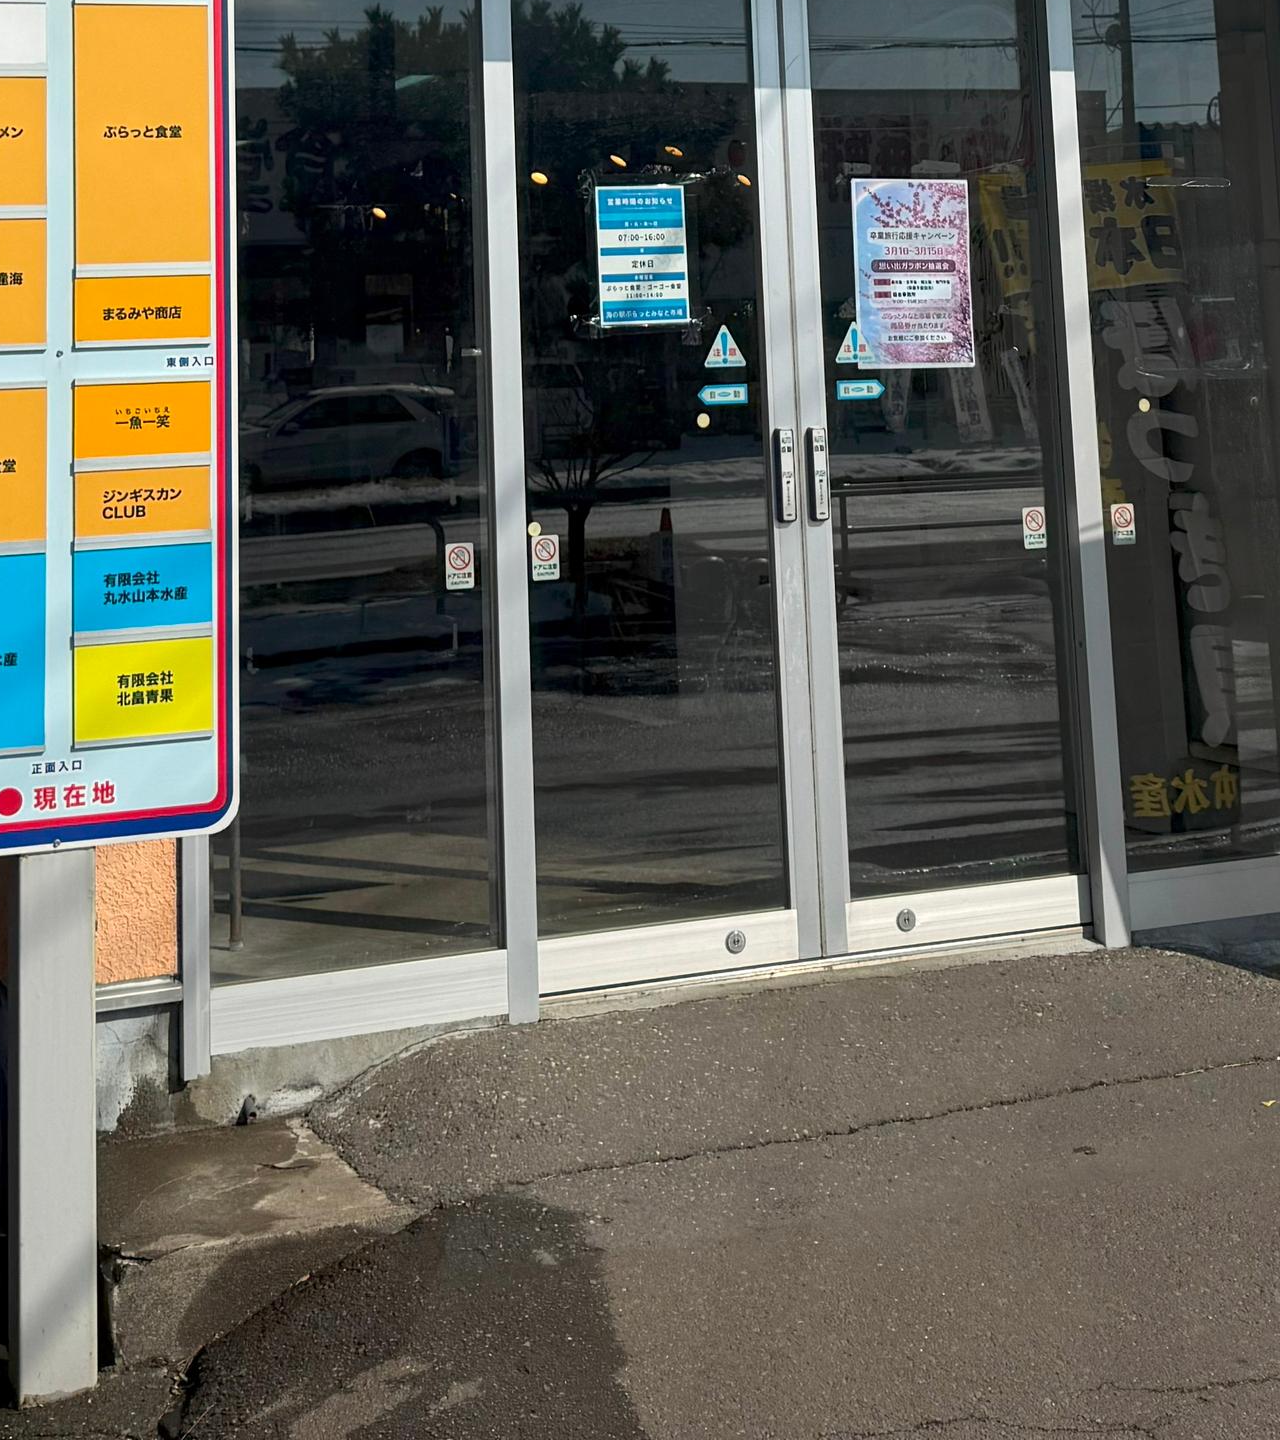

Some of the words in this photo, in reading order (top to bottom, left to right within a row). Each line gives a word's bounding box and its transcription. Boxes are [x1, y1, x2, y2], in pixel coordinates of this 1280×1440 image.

[103, 125, 183, 139] ぷらっと食堂
[631, 259, 654, 268] 定休日
[102, 306, 182, 321] まるみや商店
[166, 356, 214, 367] 東側入口
[115, 415, 170, 429] 一魚一笑
[102, 487, 183, 504] ジンギスカン
[102, 504, 147, 519] CLUB
[103, 571, 160, 587] 有限会社
[103, 587, 188, 605] 丸水山本水産
[117, 670, 174, 687] 有限会社
[31, 759, 83, 775] 正面入口
[34, 781, 115, 810] 現在地
